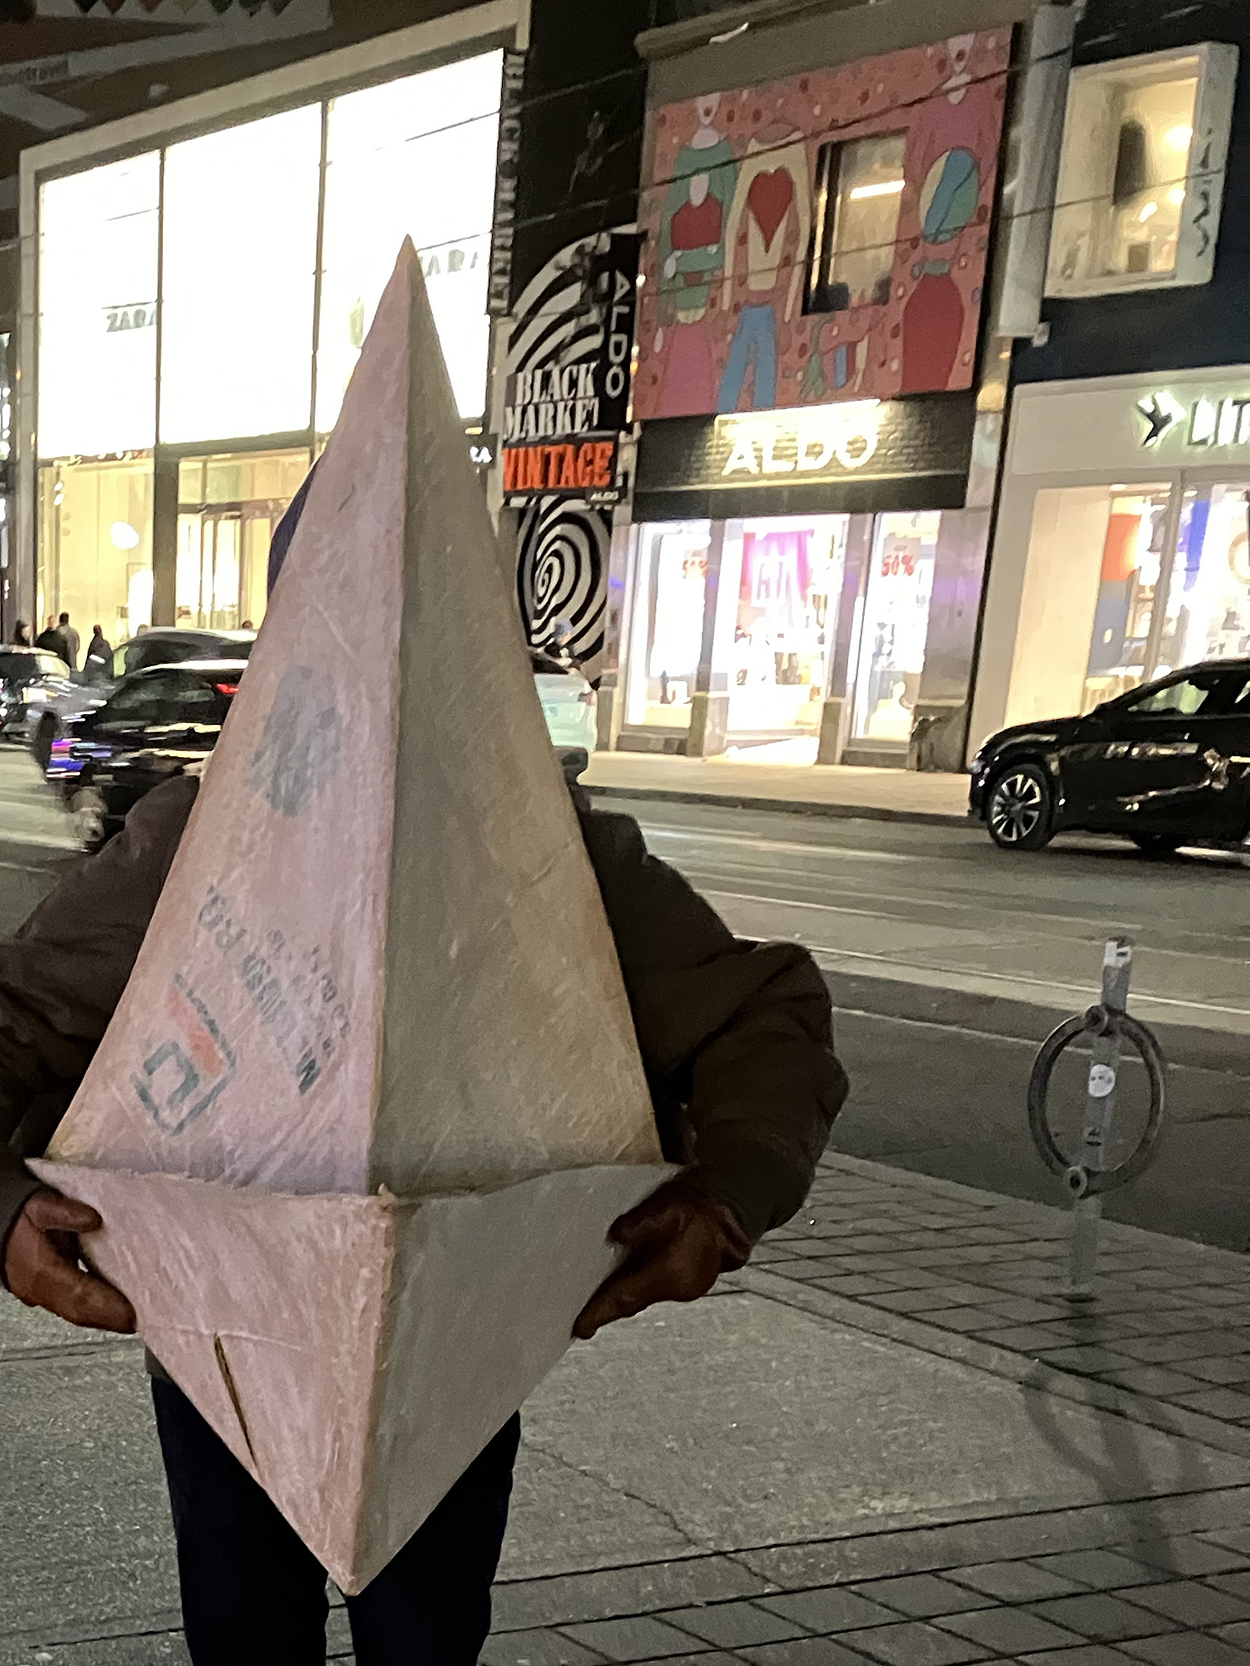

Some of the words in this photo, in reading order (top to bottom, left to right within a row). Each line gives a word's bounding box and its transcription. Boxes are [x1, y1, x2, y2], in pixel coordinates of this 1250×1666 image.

[605, 269, 631, 399] ALDO
[515, 359, 599, 405] BLACK
[503, 397, 600, 442] MARKET
[503, 441, 614, 491] VINTAGE
[721, 423, 879, 477] ALDO
